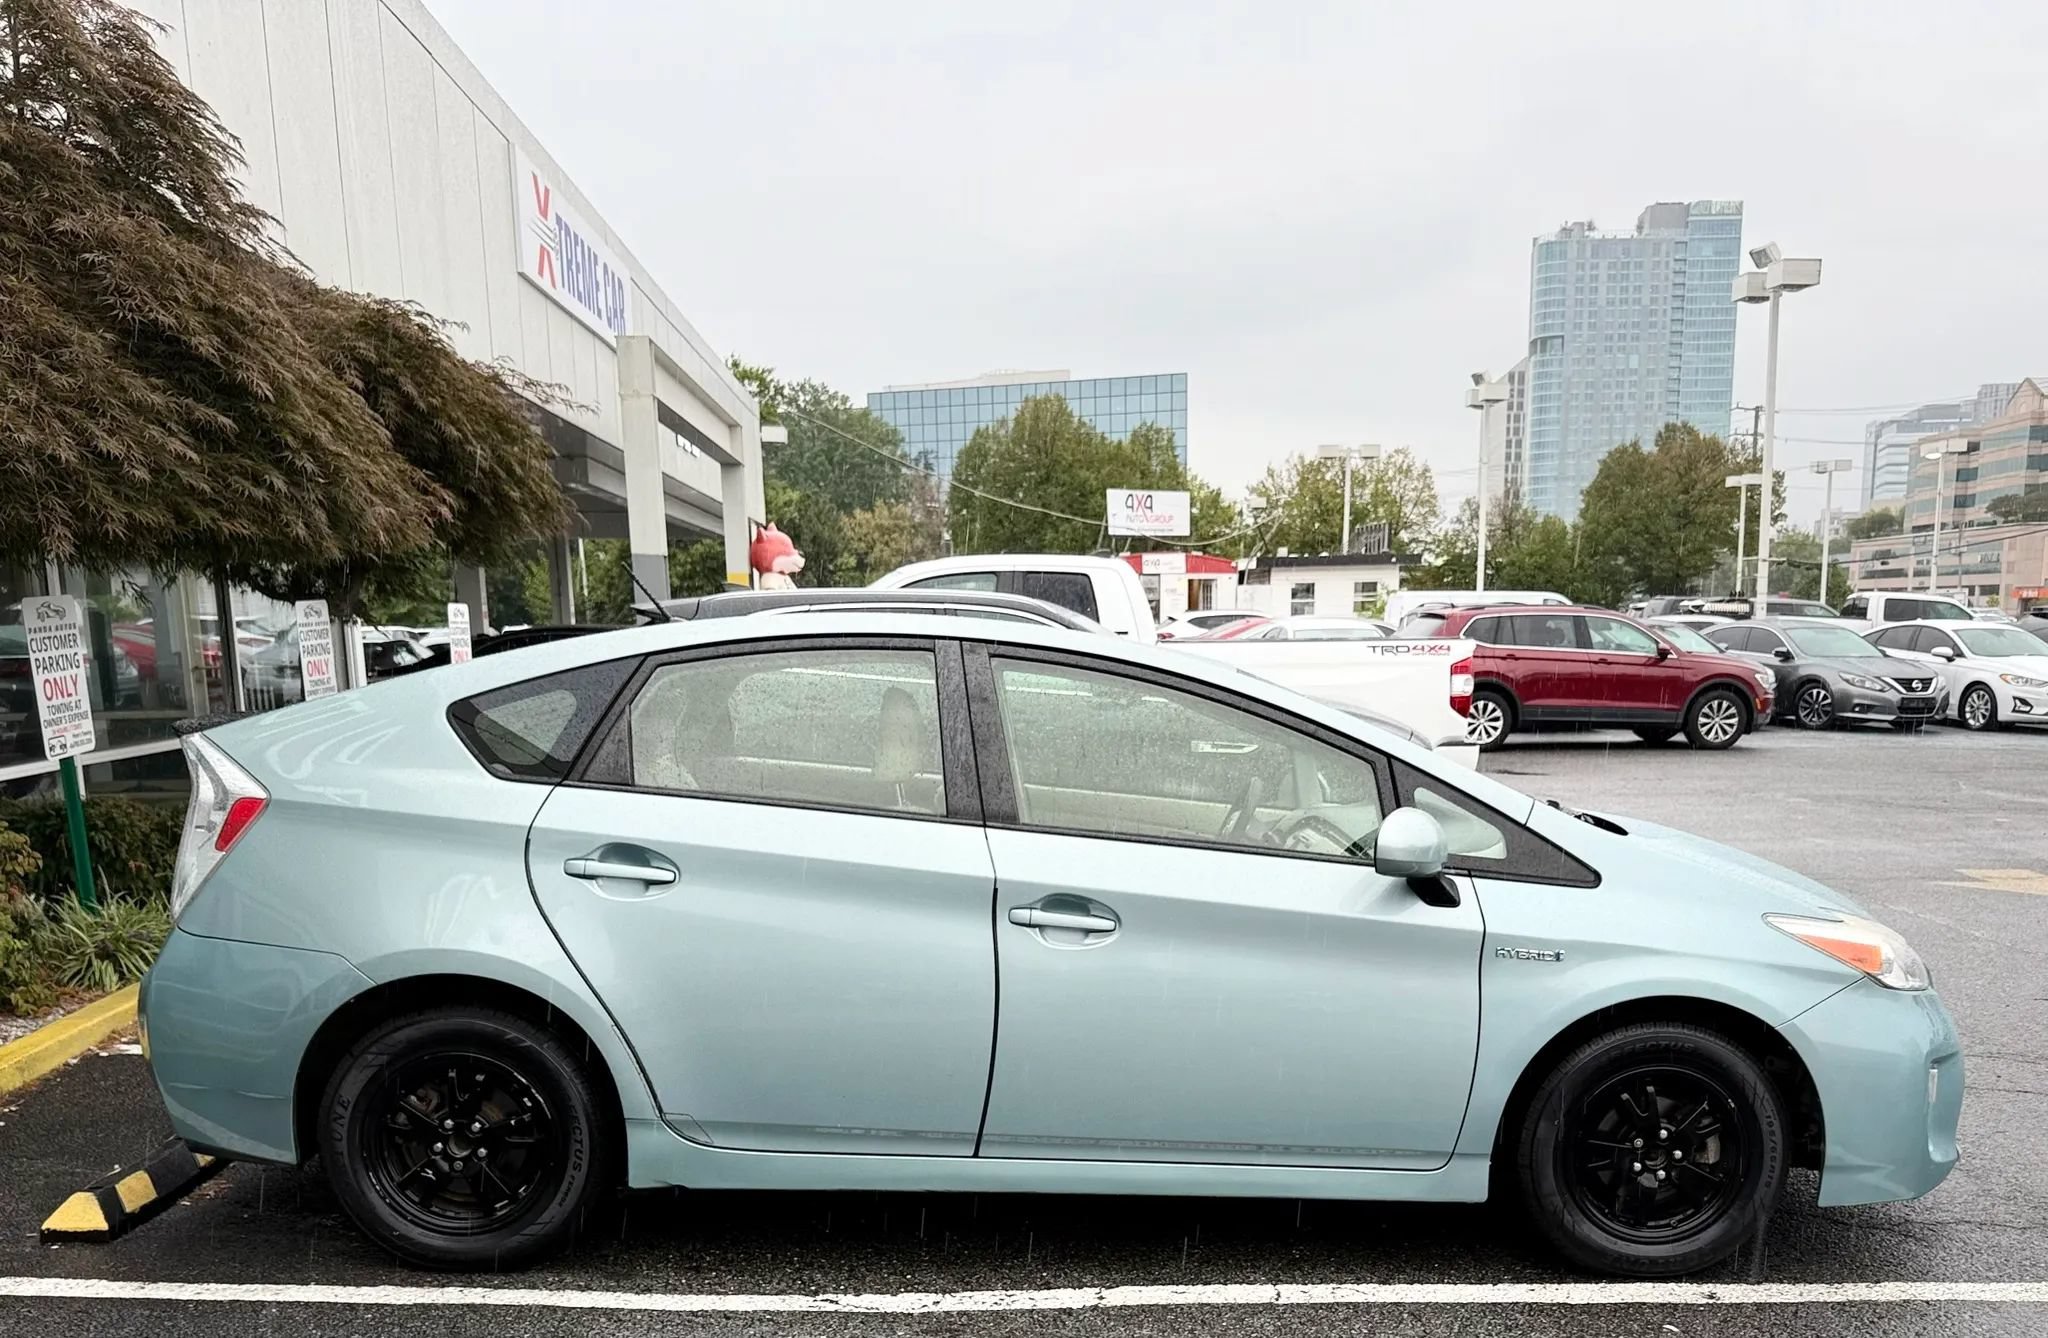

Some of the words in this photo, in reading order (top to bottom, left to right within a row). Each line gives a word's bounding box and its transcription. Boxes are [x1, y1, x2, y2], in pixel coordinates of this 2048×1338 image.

[603, 261, 627, 337] CAR
[28, 626, 52, 634] PANDA
[300, 628, 329, 642] CUSTOMER
[29, 633, 79, 654] CUSTOMER
[302, 642, 331, 657] PARKING
[1366, 645, 1410, 656] TRD
[1412, 645, 1451, 653] 4X4
[34, 653, 80, 676] PARKING
[307, 659, 329, 677] ONLY
[43, 674, 79, 701] ONLY
[46, 702, 73, 716] TOWING
[74, 699, 82, 711] AT
[43, 714, 67, 729] OWNER'S
[68, 710, 89, 724] EXPENSE
[1495, 946, 1556, 962] HYBRID
